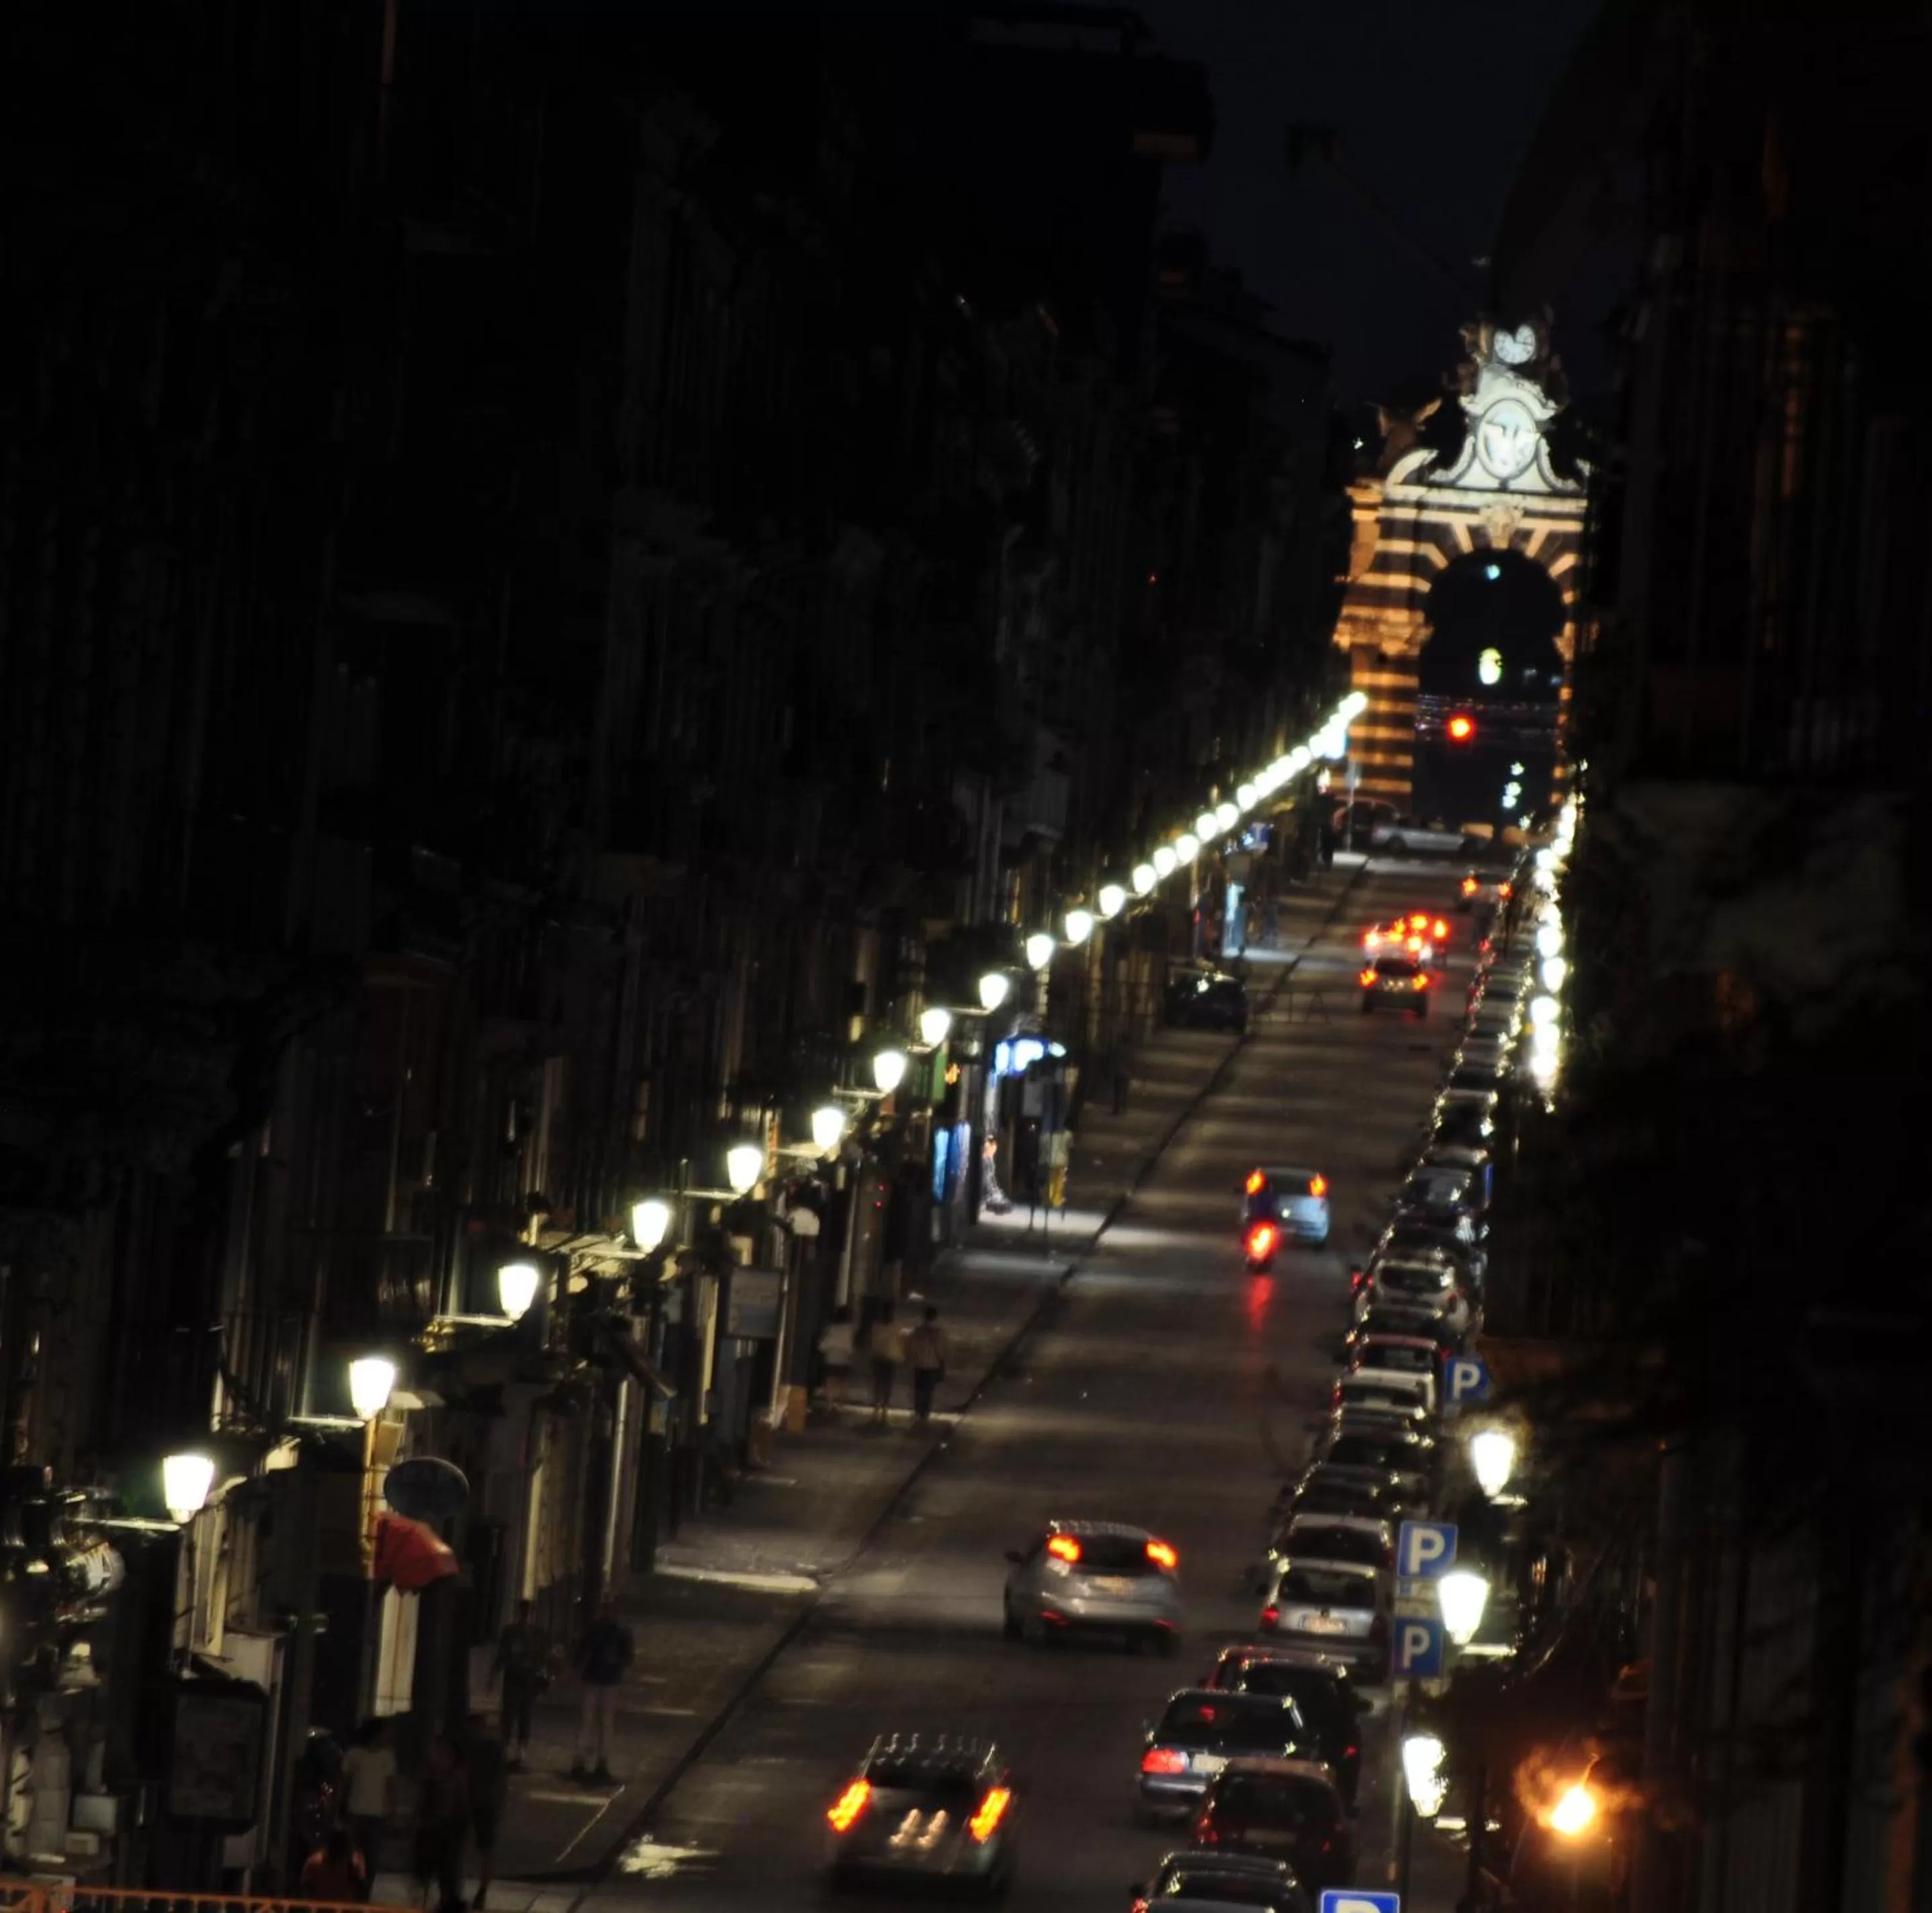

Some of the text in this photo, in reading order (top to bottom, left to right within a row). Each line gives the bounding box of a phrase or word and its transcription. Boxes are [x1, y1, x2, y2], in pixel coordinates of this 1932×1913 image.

[1453, 1362, 1481, 1400] P
[1409, 1527, 1446, 1574] P
[1403, 1625, 1430, 1668] P
